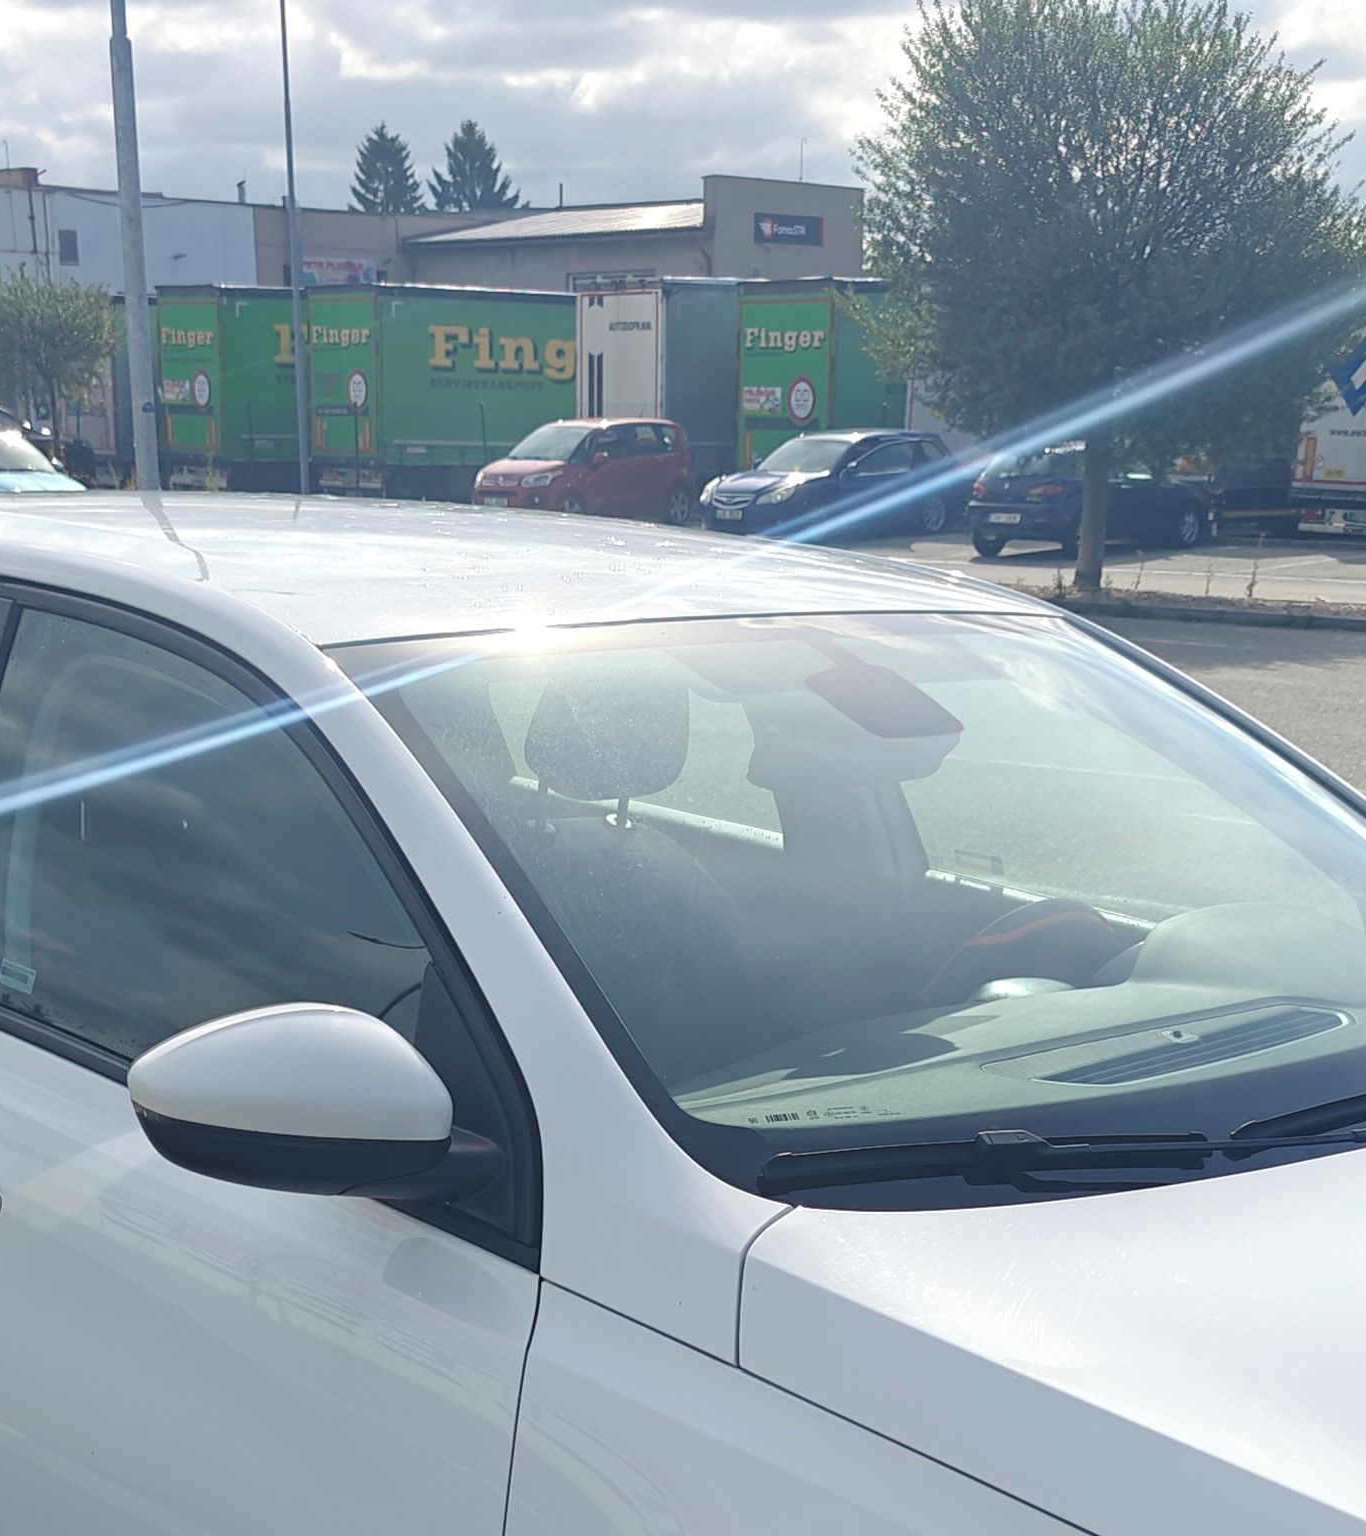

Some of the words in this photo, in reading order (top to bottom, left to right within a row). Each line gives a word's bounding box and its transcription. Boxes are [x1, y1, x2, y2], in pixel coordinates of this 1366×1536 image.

[160, 327, 215, 348] Finger
[310, 325, 371, 347] Finger
[744, 327, 825, 352] Finger
